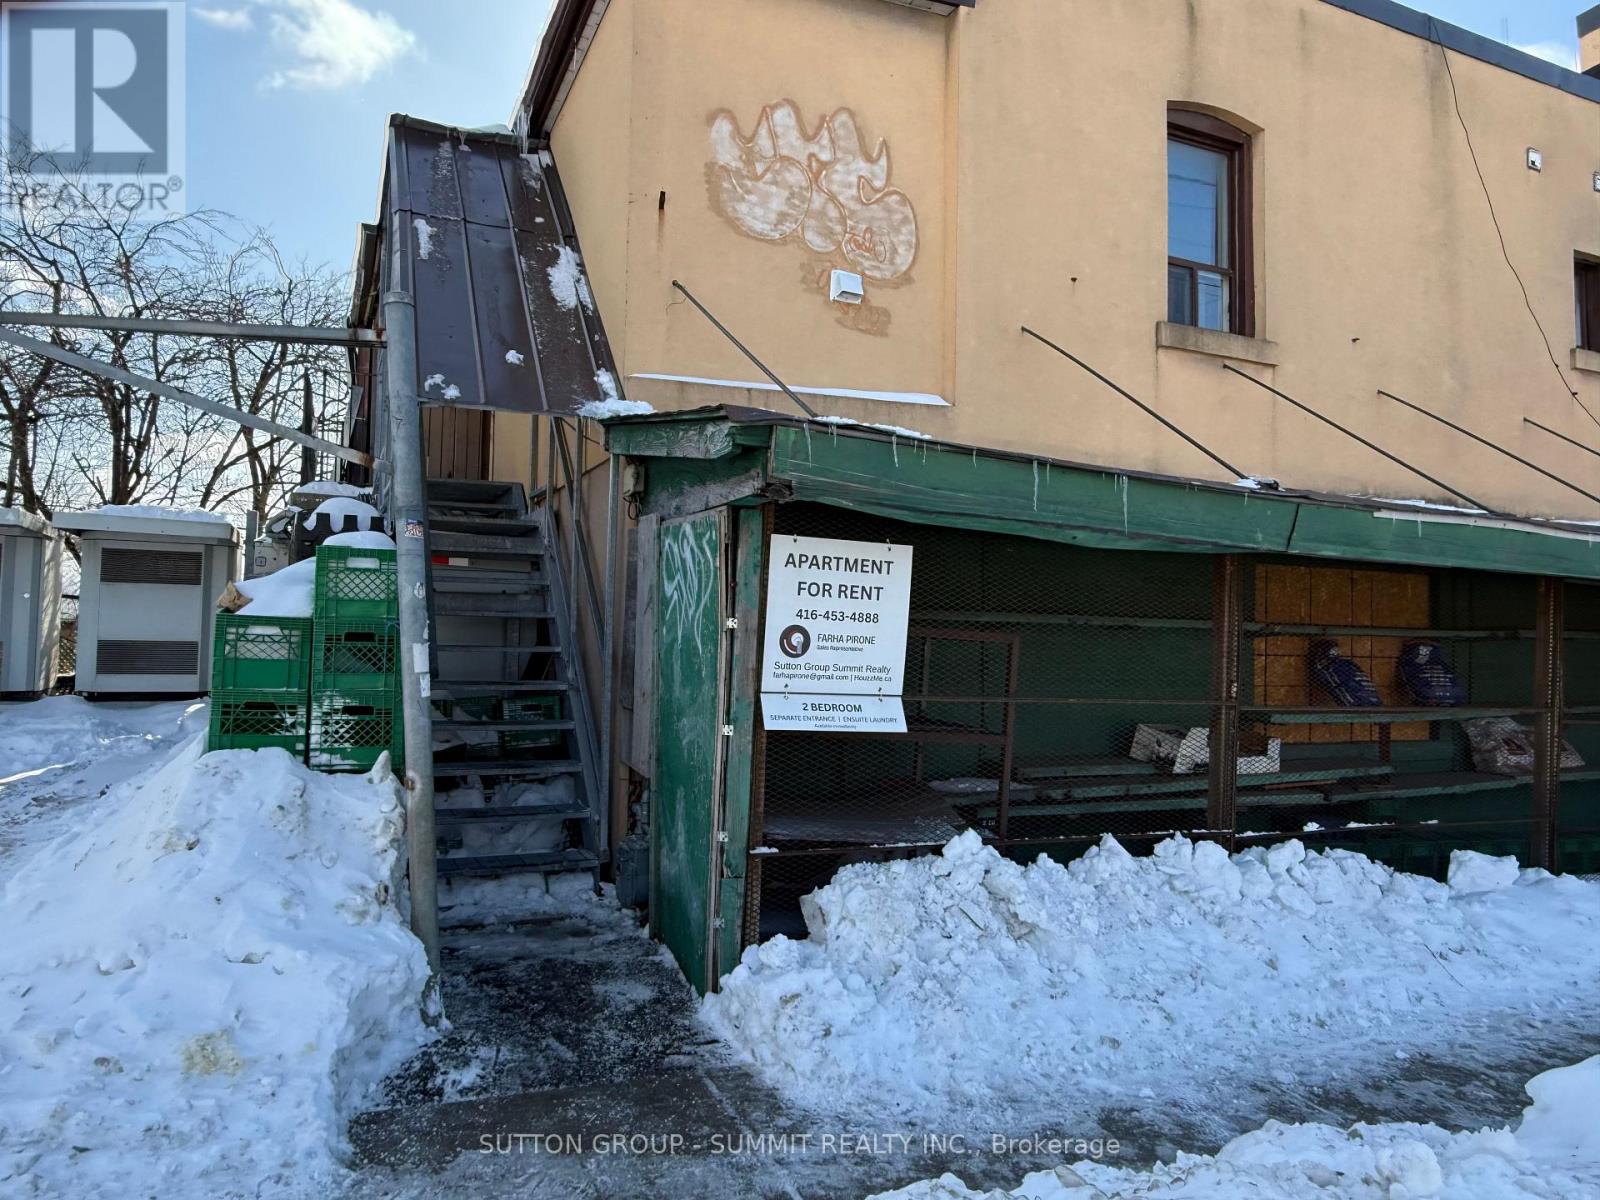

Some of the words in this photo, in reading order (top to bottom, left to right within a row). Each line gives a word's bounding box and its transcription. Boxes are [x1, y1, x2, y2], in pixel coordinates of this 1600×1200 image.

[784, 553, 894, 576] APARTMENT
[797, 581, 832, 598] FOR
[838, 584, 884, 601] RENT
[796, 609, 879, 624] 416-453-4888
[817, 633, 844, 644] FARHA
[845, 634, 876, 645] PIRONE
[774, 661, 801, 672] Sutton
[804, 663, 830, 674] Group
[832, 663, 863, 673] Summit
[866, 665, 891, 676] Realty
[802, 703, 809, 711] 2
[811, 703, 862, 713] BEDROOM
[803, 715, 836, 723] ENTRANCE
